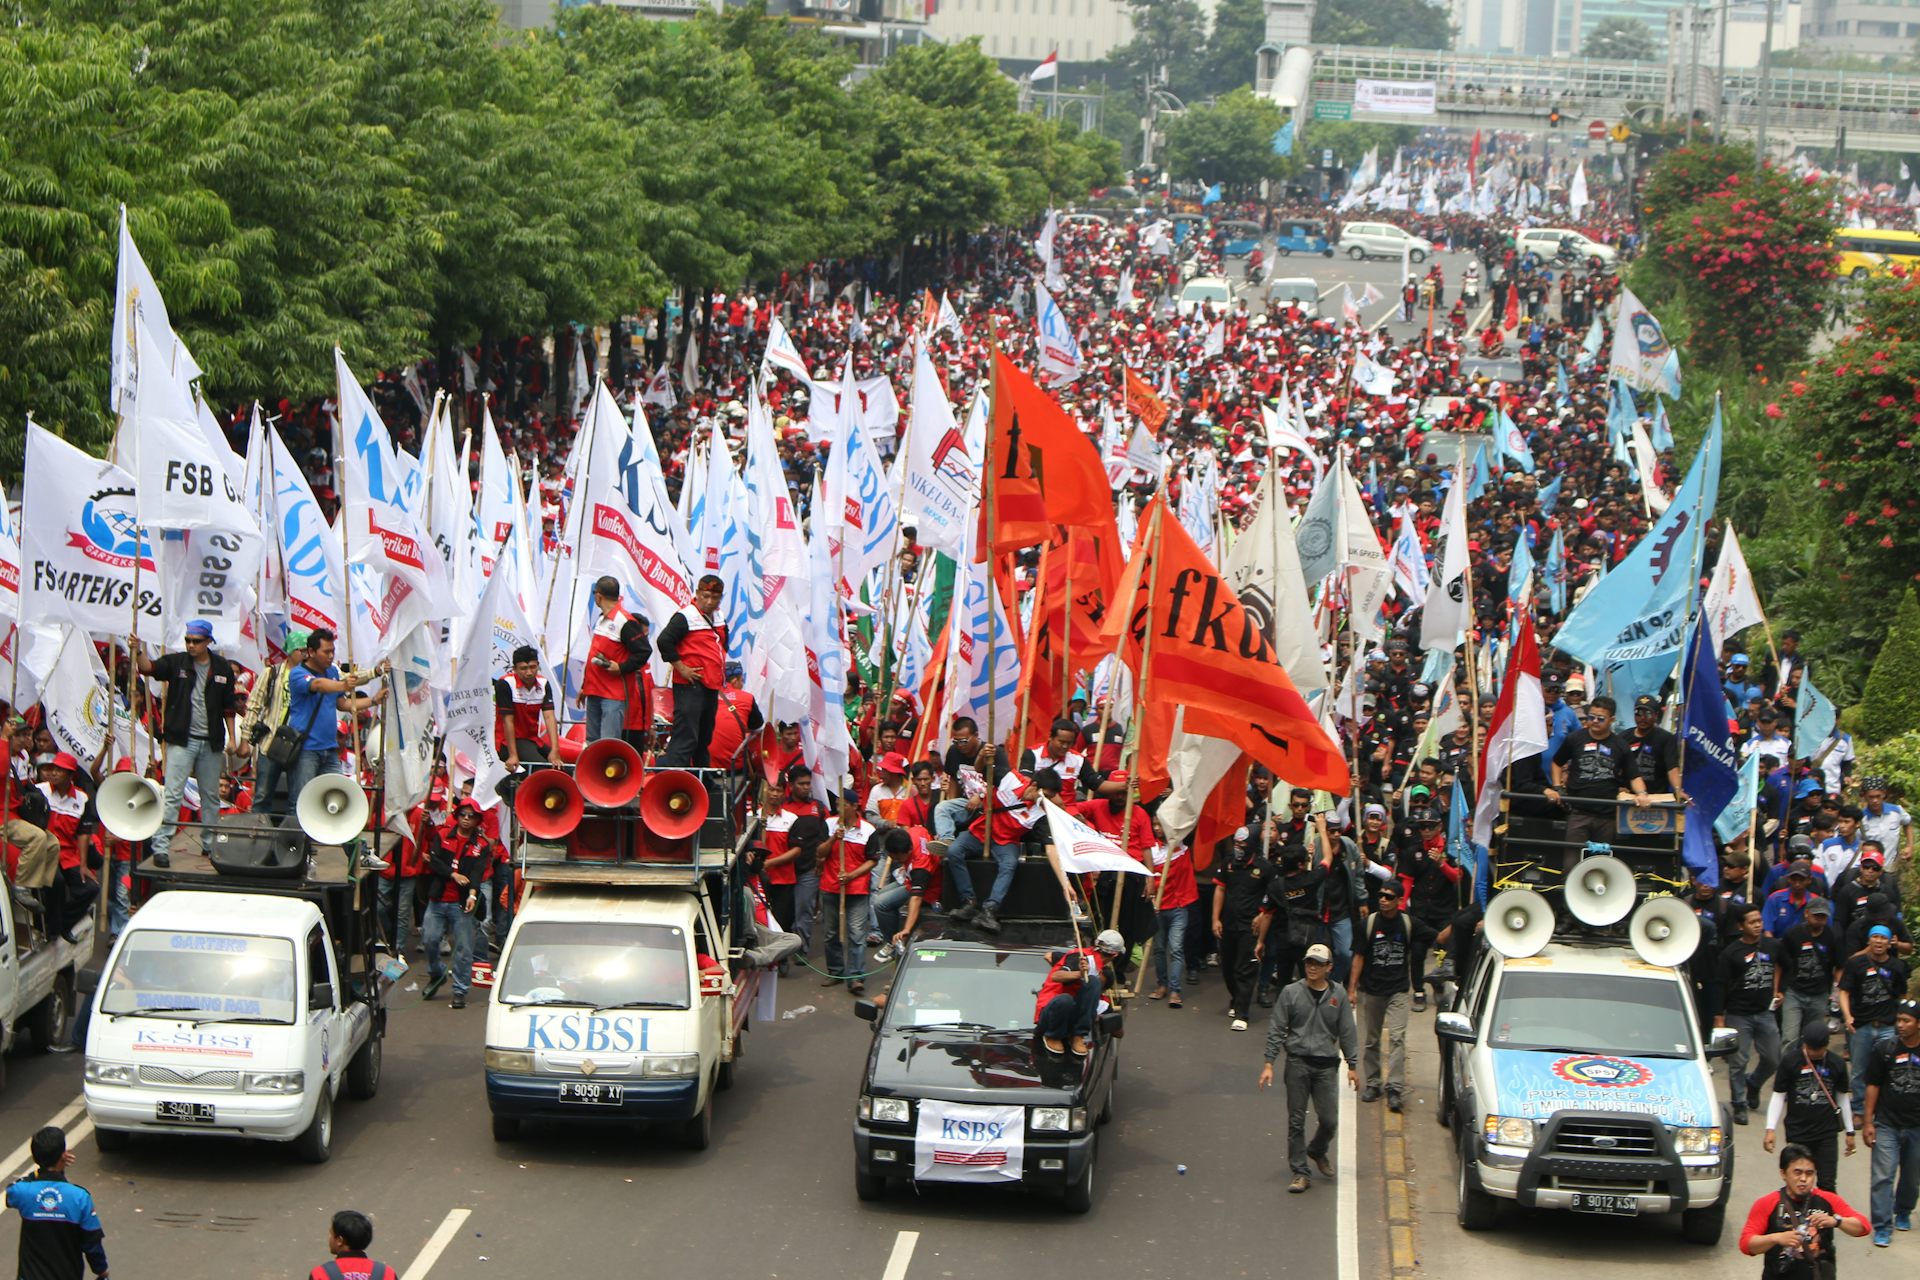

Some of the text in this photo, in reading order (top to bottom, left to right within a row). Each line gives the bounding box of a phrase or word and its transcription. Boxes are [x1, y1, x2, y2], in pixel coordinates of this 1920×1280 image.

[166, 460, 213, 496] FSB
[85, 545, 136, 568] GARTEKS
[649, 561, 676, 592] Buruh
[1161, 568, 1278, 667] fku
[57, 725, 87, 758] KIKES
[170, 935, 247, 952] GARTEKS
[224, 999, 261, 1015] RAYA
[524, 1014, 655, 1052] KSBSI
[1586, 1068, 1616, 1076] SPSI
[561, 1083, 622, 1099] B 9050 XY
[1528, 1089, 1692, 1108] PUK SPKEP SPSI
[157, 1101, 165, 1114] B
[170, 1102, 195, 1116] 9401
[1522, 1102, 1536, 1117] PT
[1572, 1195, 1638, 1210] B 9012 KSW
